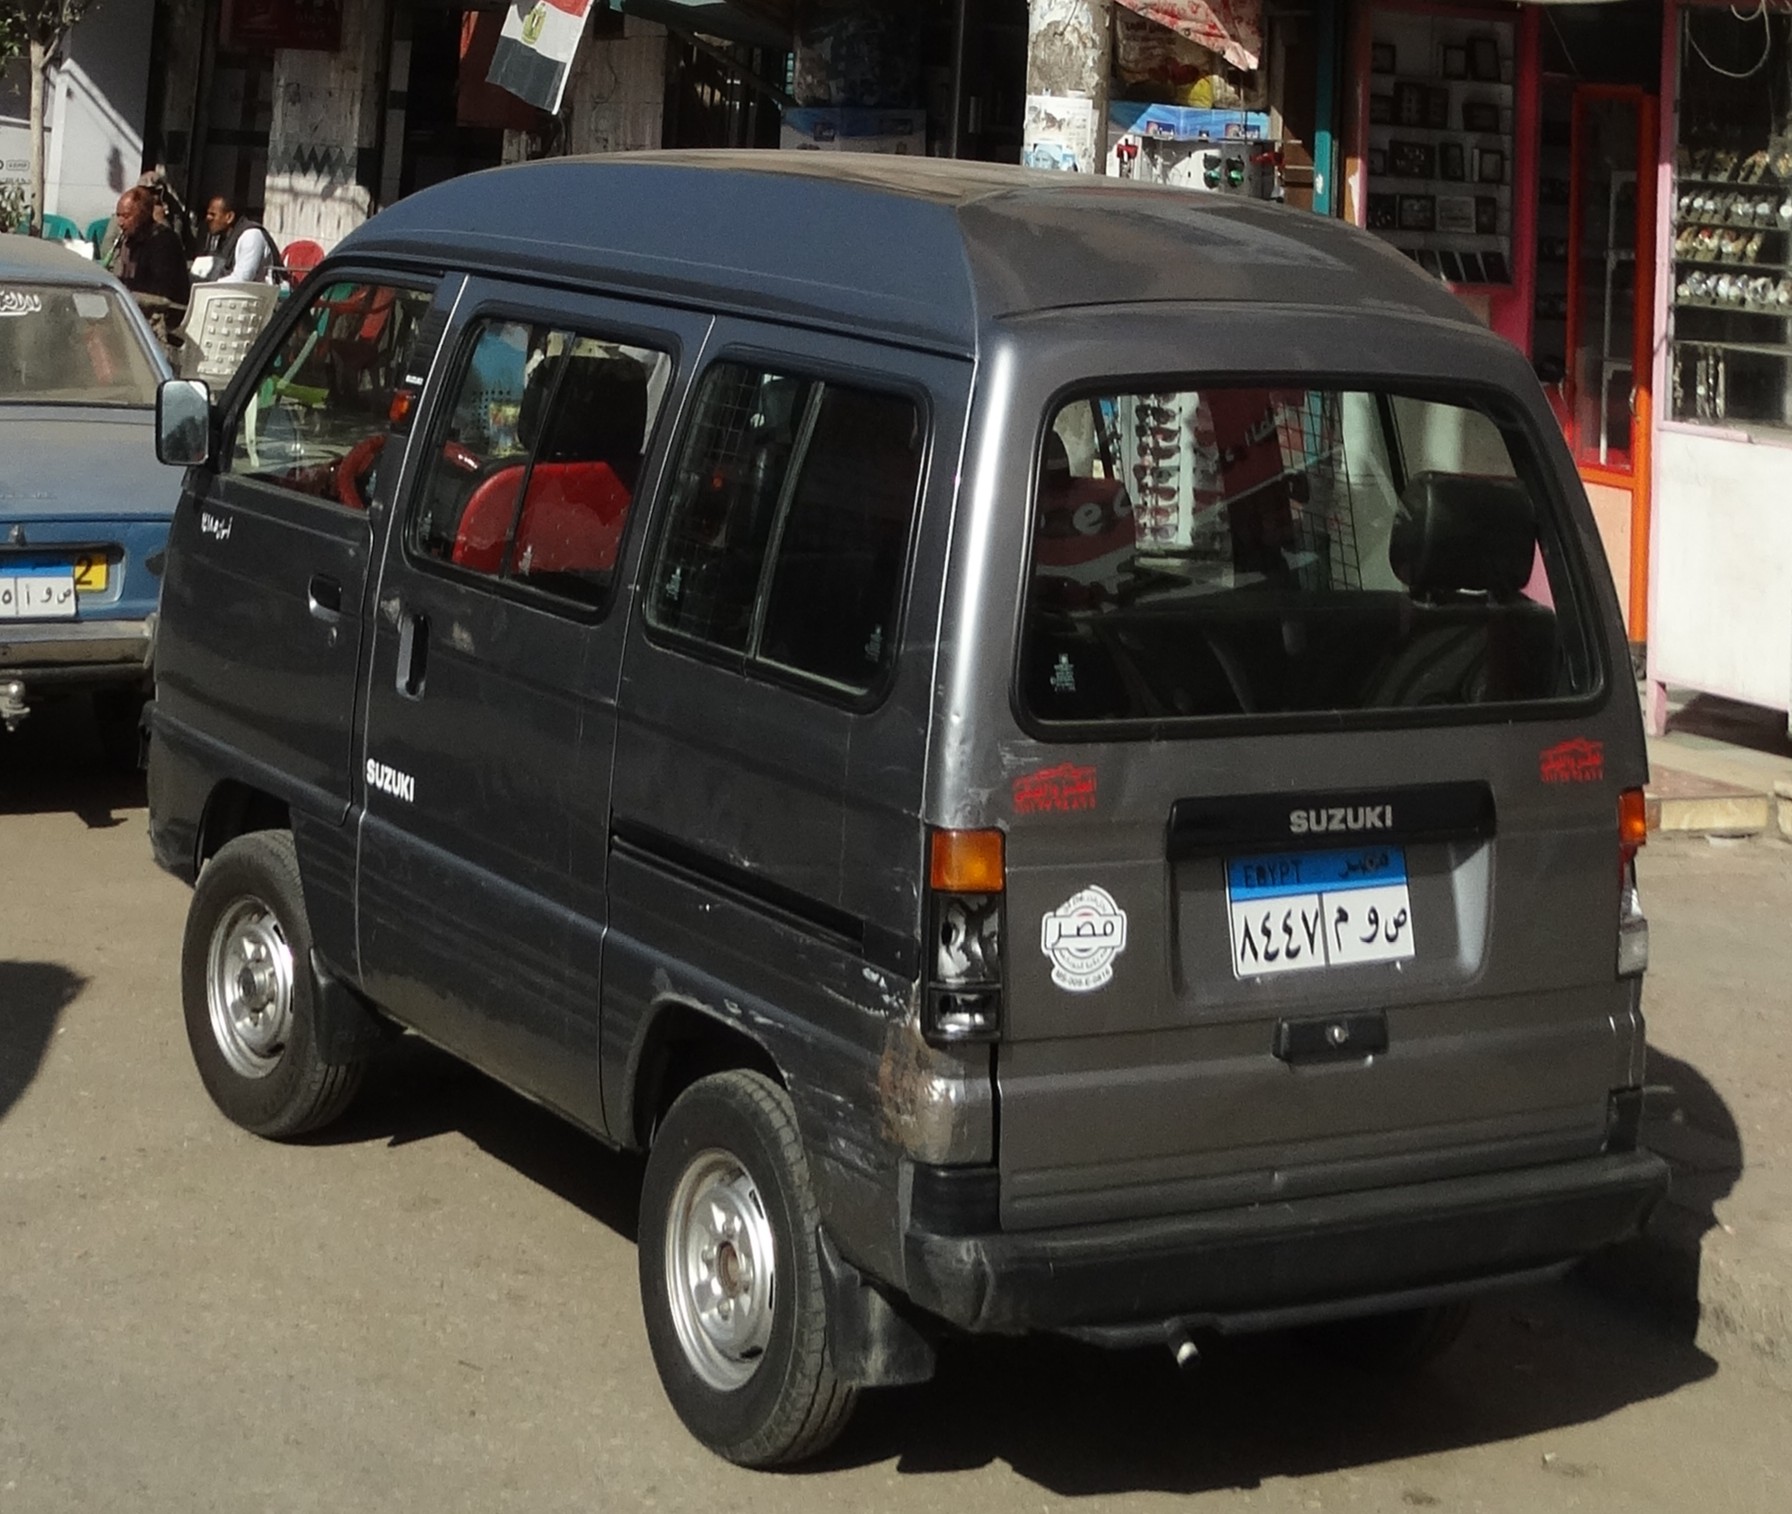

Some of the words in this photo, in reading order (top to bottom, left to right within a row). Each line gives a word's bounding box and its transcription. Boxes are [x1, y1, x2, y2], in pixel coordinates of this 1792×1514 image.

[366, 757, 415, 803] SUZUKI
[1289, 804, 1393, 833] SUZUKI
[1051, 920, 1115, 948] مصر
